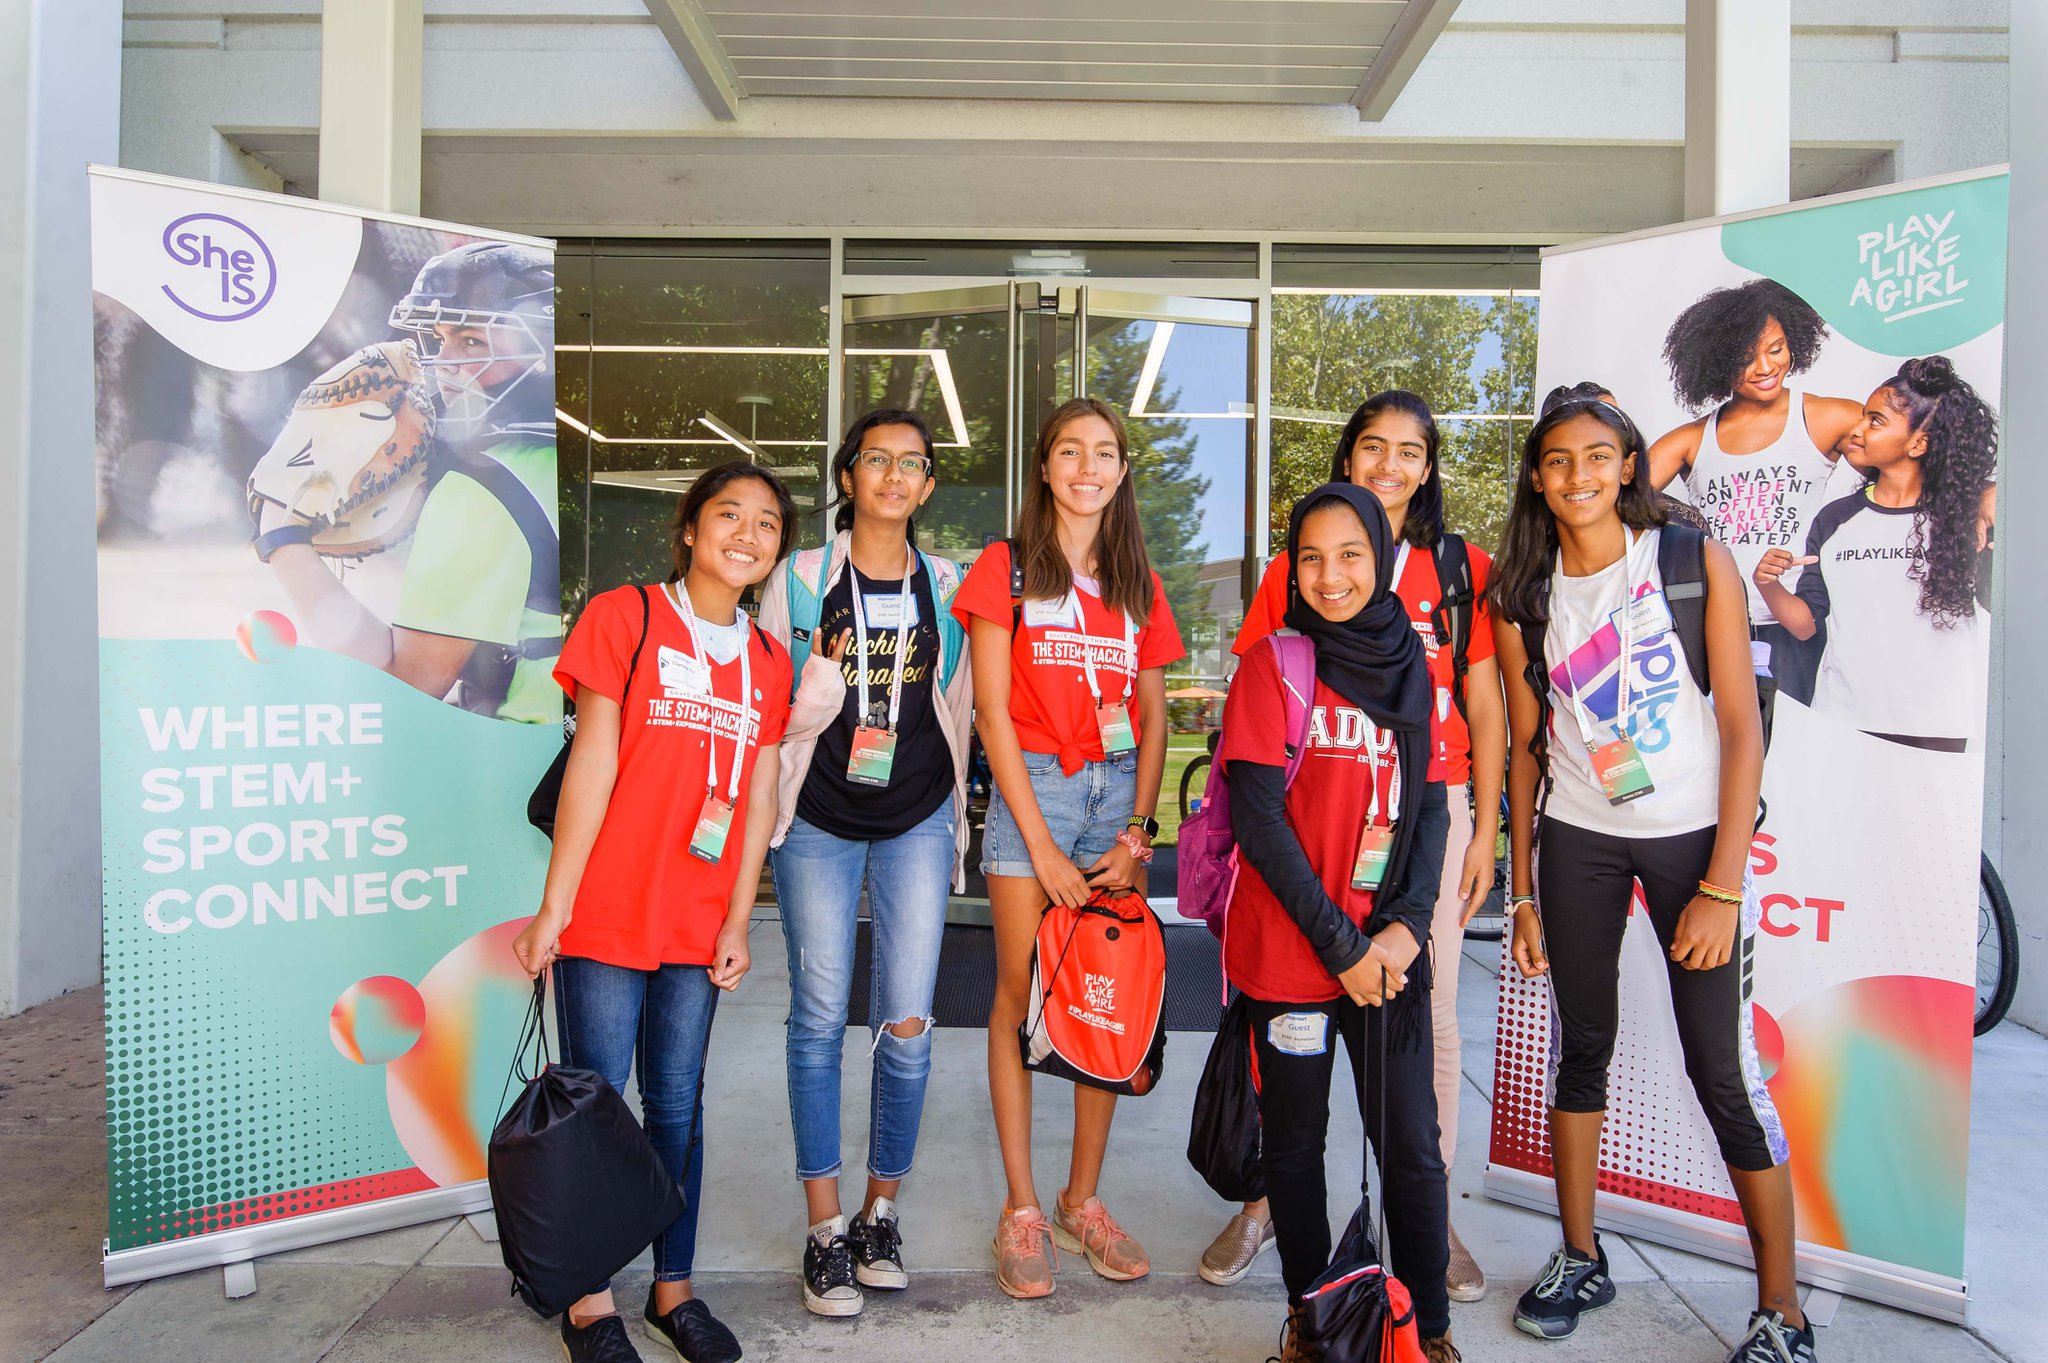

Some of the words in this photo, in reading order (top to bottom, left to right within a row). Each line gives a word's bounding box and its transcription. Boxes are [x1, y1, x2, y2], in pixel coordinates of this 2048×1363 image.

[1857, 209, 1955, 264] PLAY
[175, 232, 255, 271] She
[1872, 234, 1960, 281] LIKE
[1708, 465, 1797, 492] ALWAYS
[1700, 479, 1812, 508] CONFIDENT
[1718, 493, 1784, 513] OFTEN
[1707, 507, 1797, 528] FEARLESS
[1736, 520, 1800, 535] NEVER
[1032, 641, 1053, 658] THE
[648, 699, 674, 718] THE
[138, 703, 383, 751] WHERE
[141, 761, 362, 813] STEM+
[142, 814, 408, 874] SPORTS
[144, 865, 468, 934] CONNECT
[1085, 973, 1115, 988] PLAY
[1088, 982, 1115, 999] LIKE
[1288, 1023, 1310, 1031] Guest
